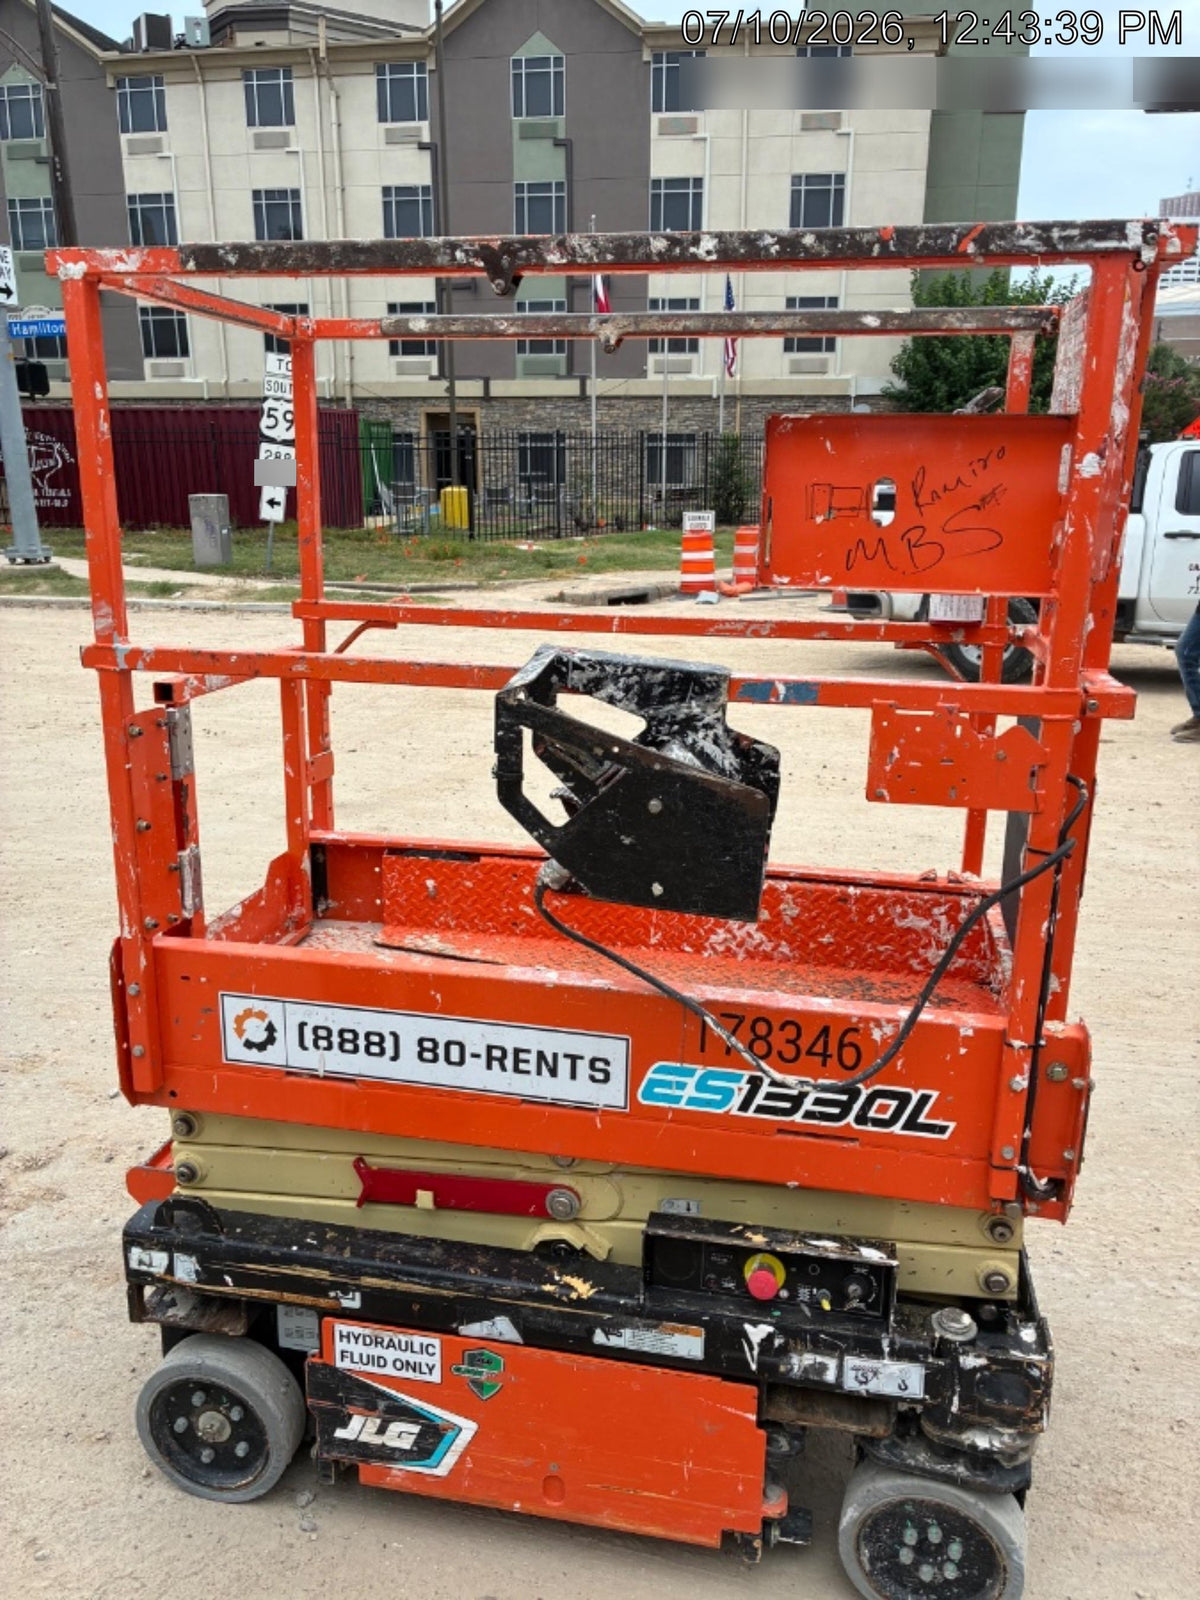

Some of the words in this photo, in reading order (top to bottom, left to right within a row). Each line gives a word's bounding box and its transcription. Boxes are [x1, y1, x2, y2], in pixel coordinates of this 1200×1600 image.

[265, 407, 294, 432] 59
[298, 1021, 401, 1062] (888)
[416, 1037, 612, 1084] 80-RENTS
[699, 1012, 863, 1072] 178346
[640, 1061, 953, 1137] ES1330L
[338, 1330, 437, 1357] HYDRAULIC
[340, 1351, 387, 1369] FLUID
[392, 1358, 436, 1377] ONLY
[333, 1414, 422, 1450] JLG
